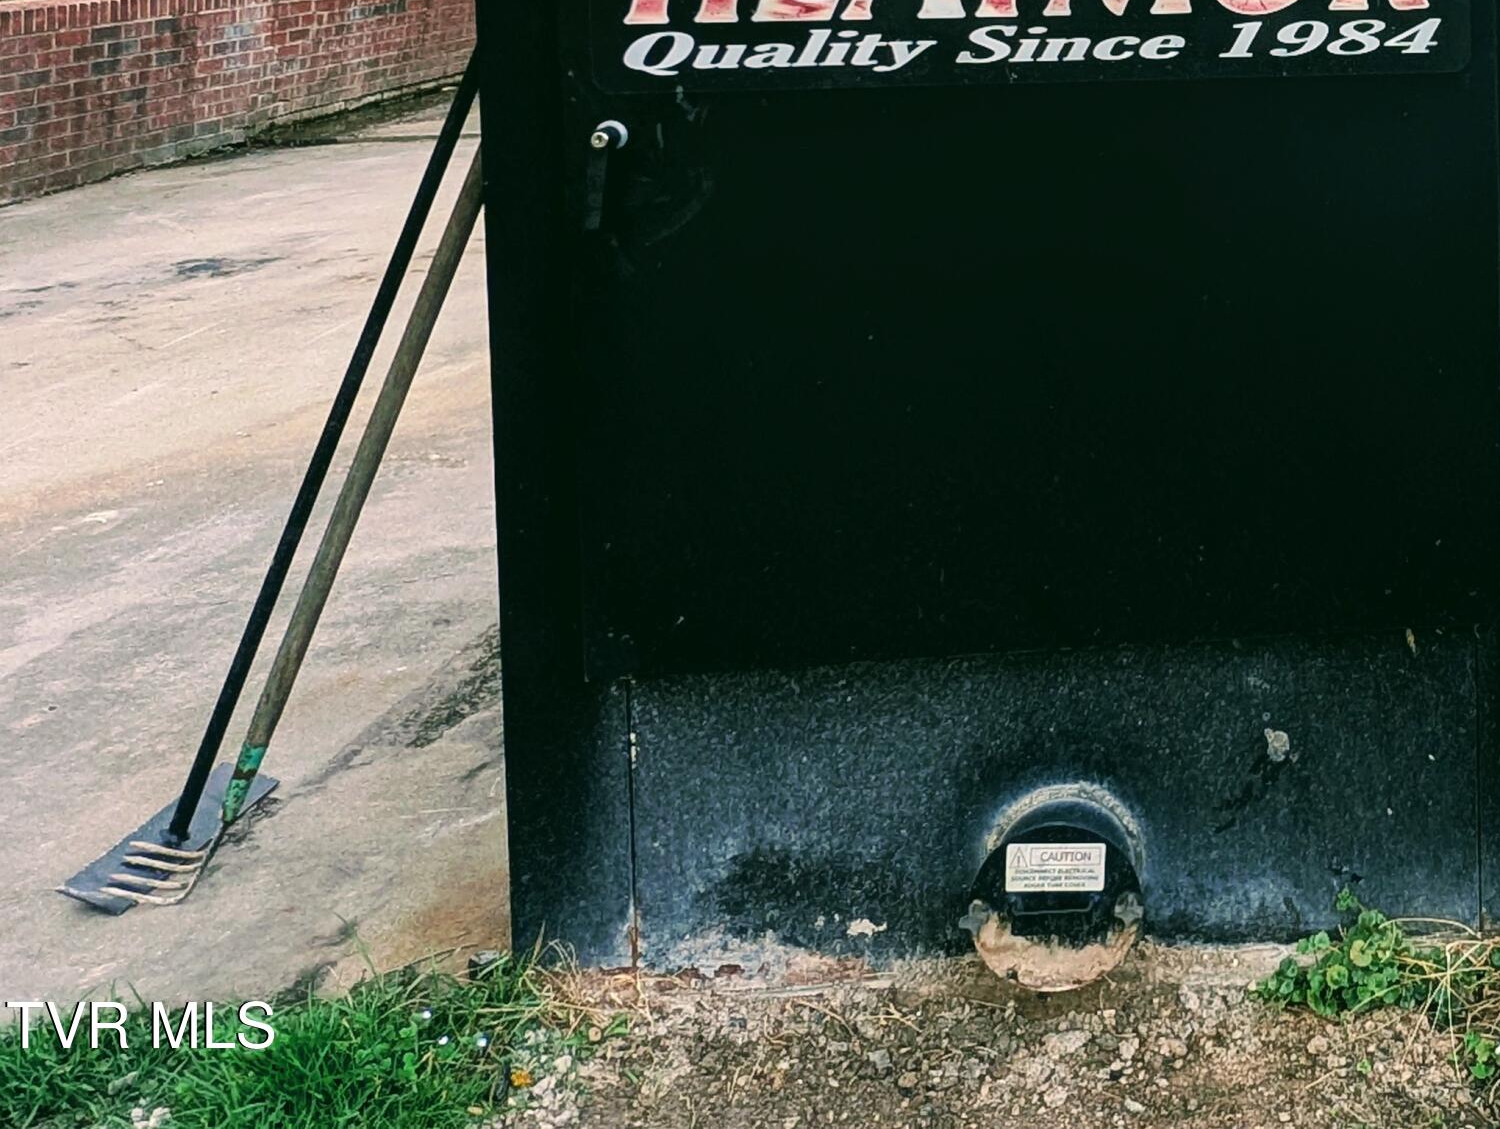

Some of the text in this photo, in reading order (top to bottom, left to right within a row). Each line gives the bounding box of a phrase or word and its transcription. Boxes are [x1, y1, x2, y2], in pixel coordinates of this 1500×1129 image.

[622, 17, 1442, 76] Quality Since 1984
[1040, 851, 1092, 862] CAUTION
